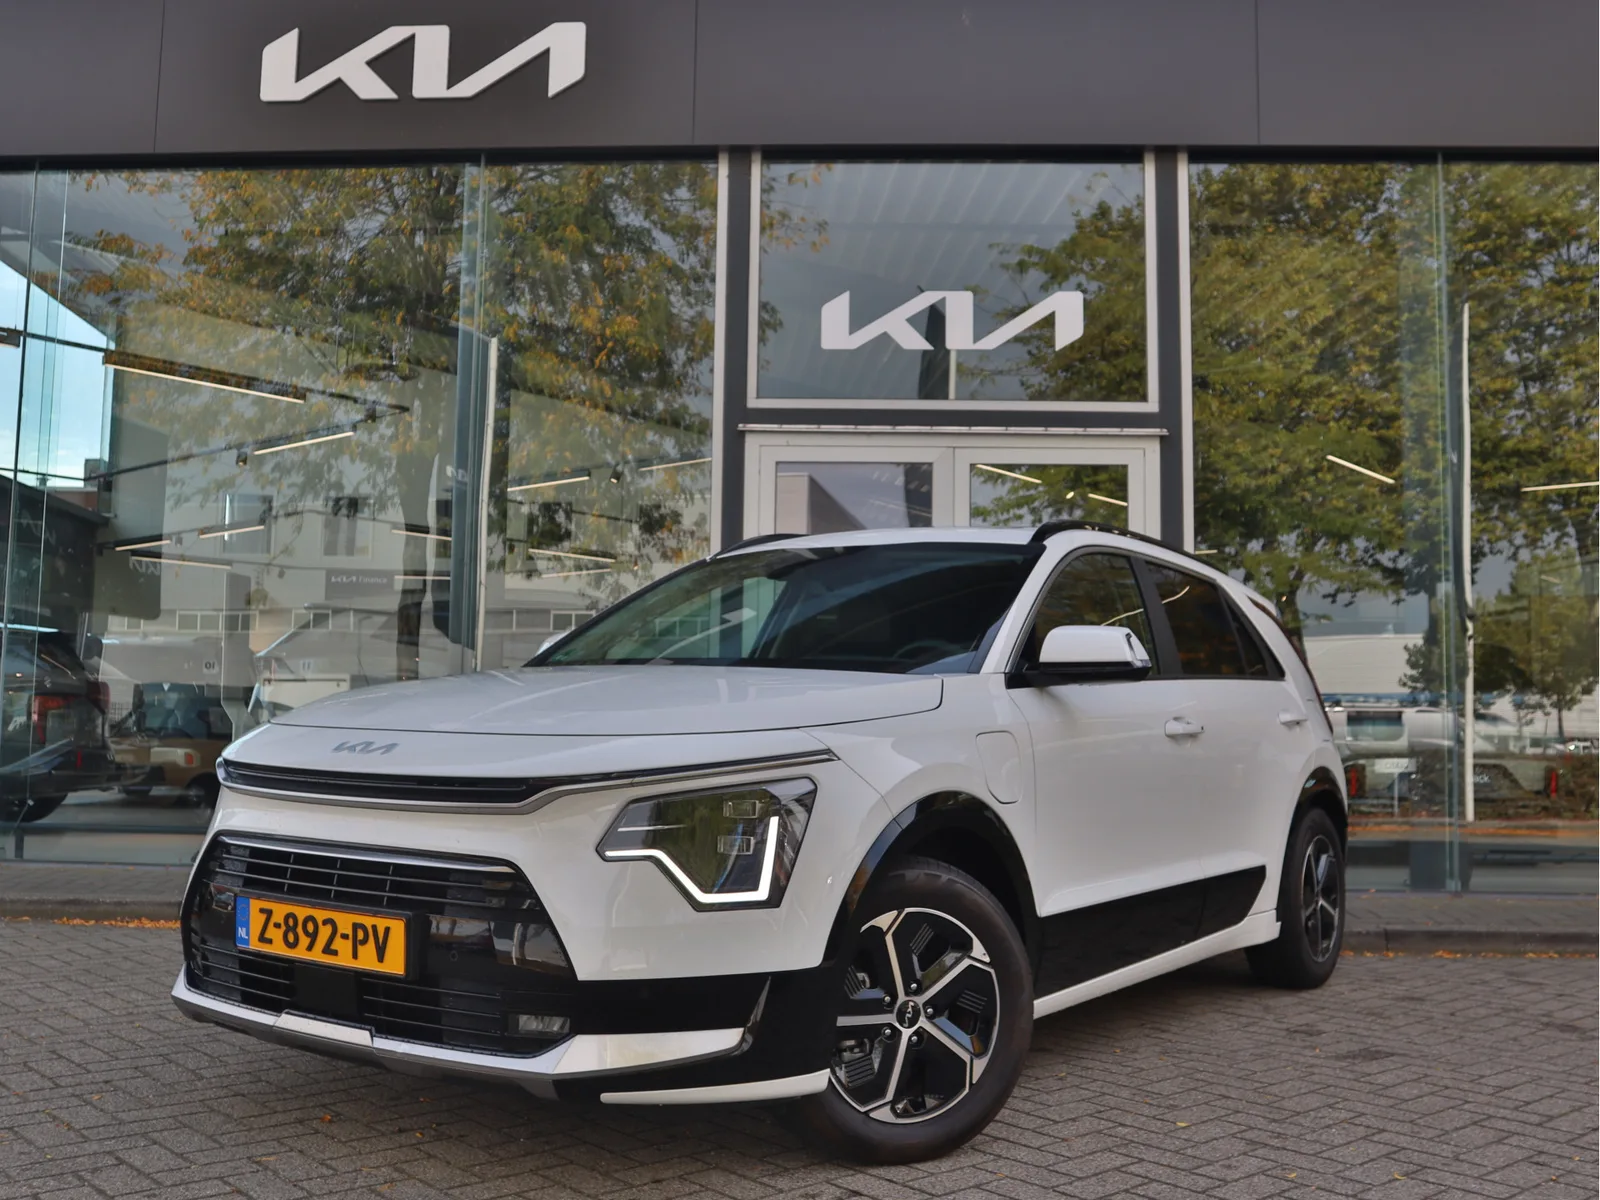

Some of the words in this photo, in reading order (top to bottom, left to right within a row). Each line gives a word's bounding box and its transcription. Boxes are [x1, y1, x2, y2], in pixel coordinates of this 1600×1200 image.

[260, 21, 587, 102] KIA
[820, 290, 1084, 351] KIA
[331, 740, 400, 756] KIA
[238, 926, 249, 940] NL
[257, 907, 391, 964] Z-892-PV
